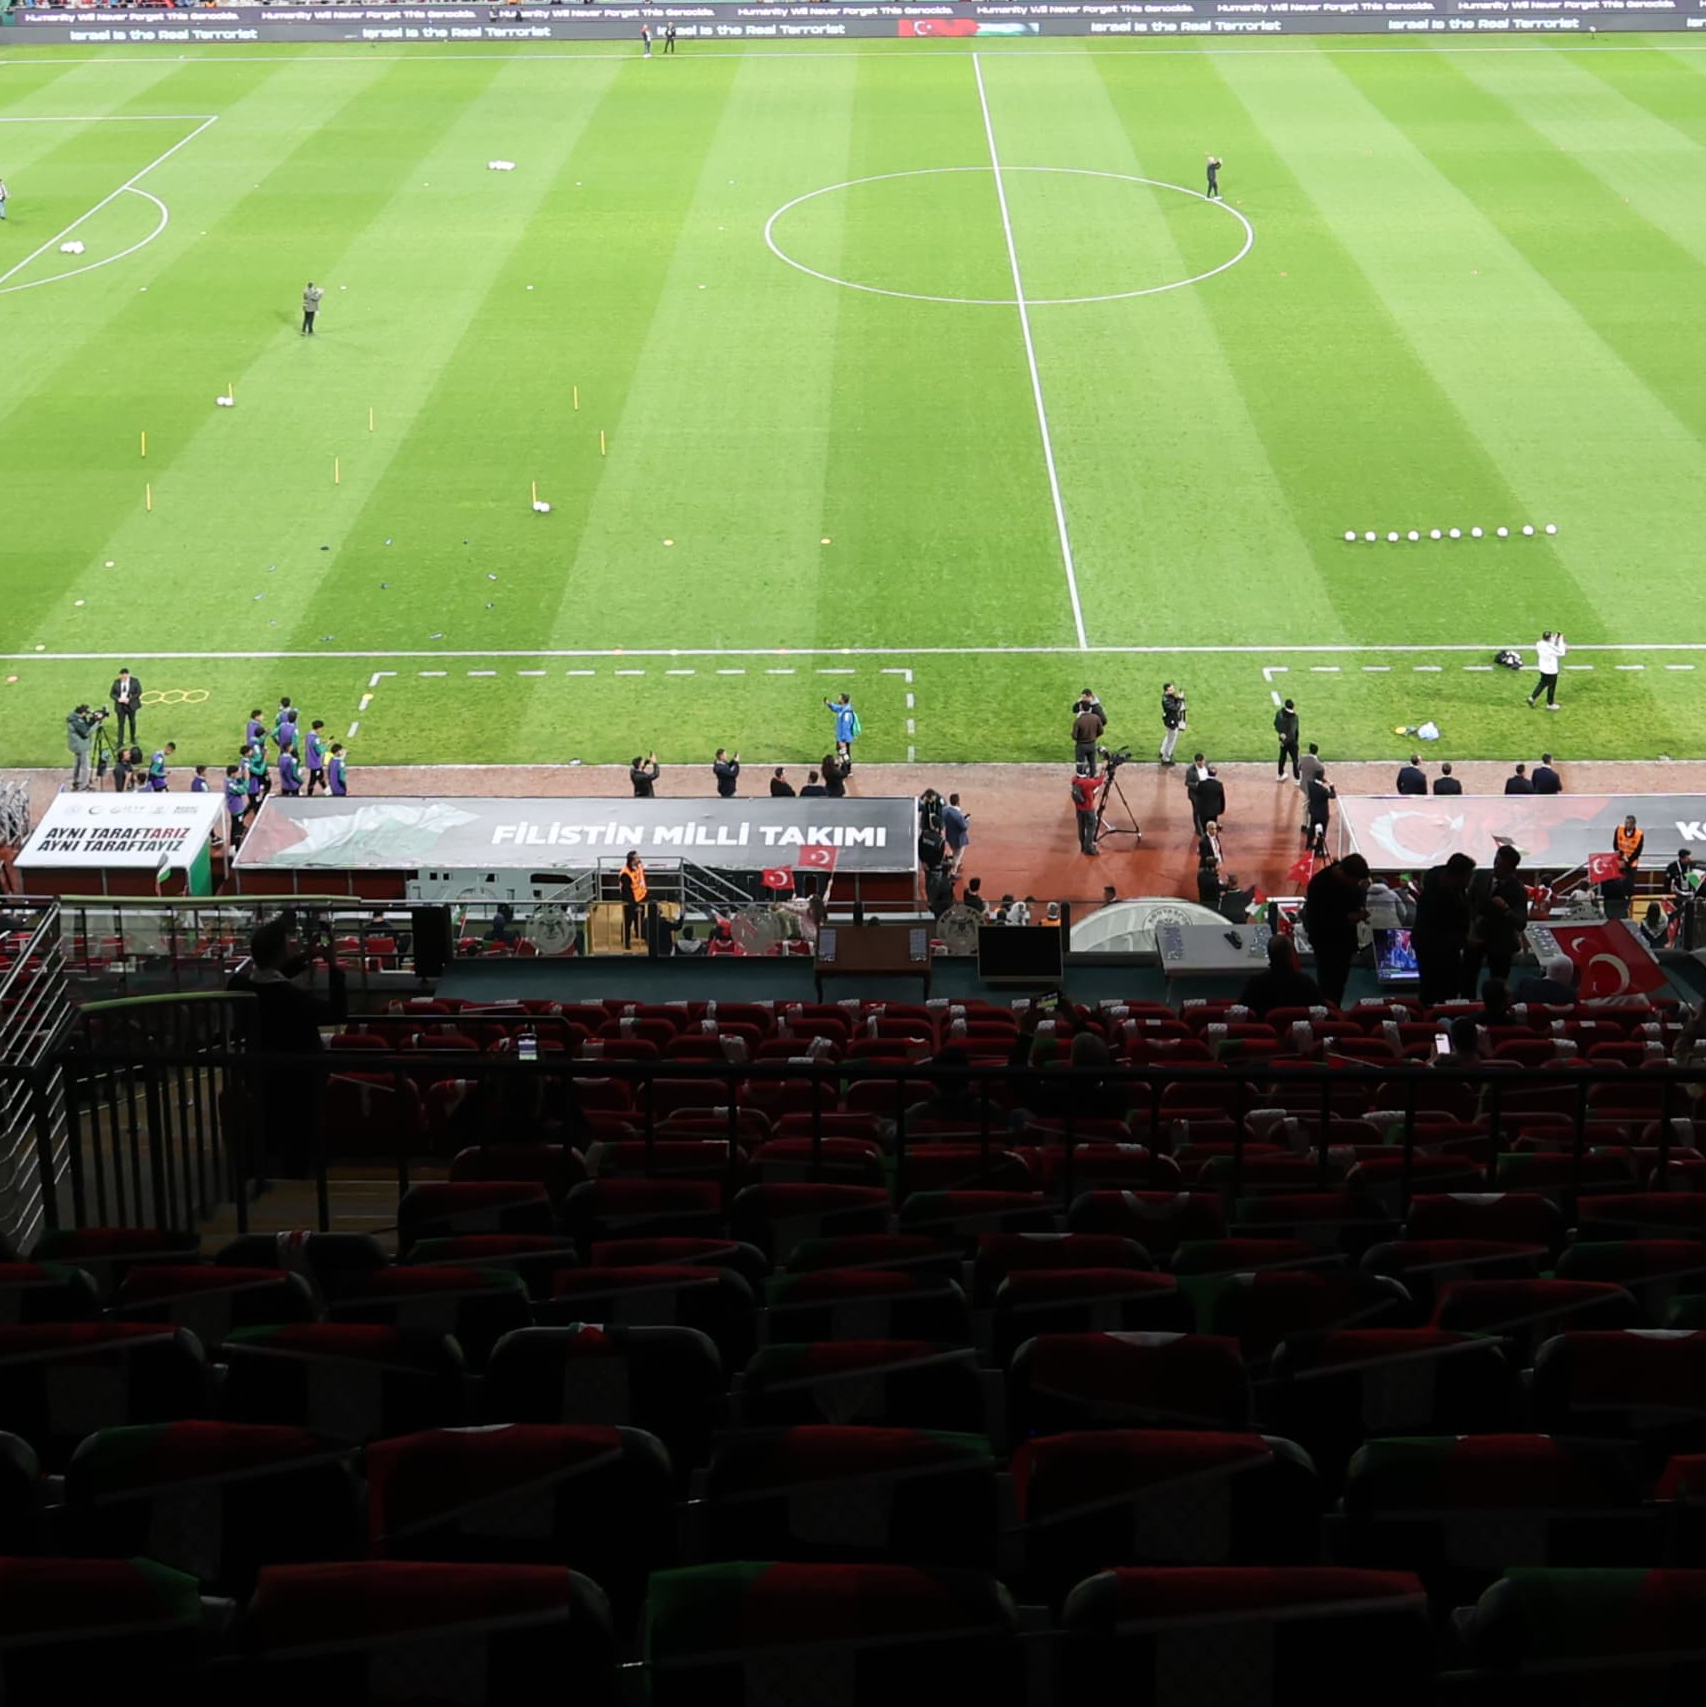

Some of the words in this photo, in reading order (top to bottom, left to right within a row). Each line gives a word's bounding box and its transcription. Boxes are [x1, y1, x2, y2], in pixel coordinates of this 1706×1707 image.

[1091, 22, 1131, 33] Israel
[1151, 22, 1177, 33] the
[1180, 22, 1211, 33] Real
[1215, 22, 1281, 33] Terrorist
[1389, 19, 1429, 30] Israel
[1449, 19, 1475, 30] the
[1478, 19, 1510, 30] Real
[1513, 19, 1579, 30] Terrorist
[70, 30, 110, 41] Israel
[130, 30, 155, 41] the
[158, 30, 189, 41] Real
[193, 30, 257, 41] Terrorist
[46, 827, 86, 839] AYNI
[92, 827, 190, 839] TARAFTARIZ
[491, 821, 643, 845] FİLİSTİN
[652, 822, 750, 845] MİLLİ
[759, 826, 886, 847] TAKIMI
[37, 839, 78, 852] AYNI
[83, 839, 184, 852] TARAFTAYIZ
